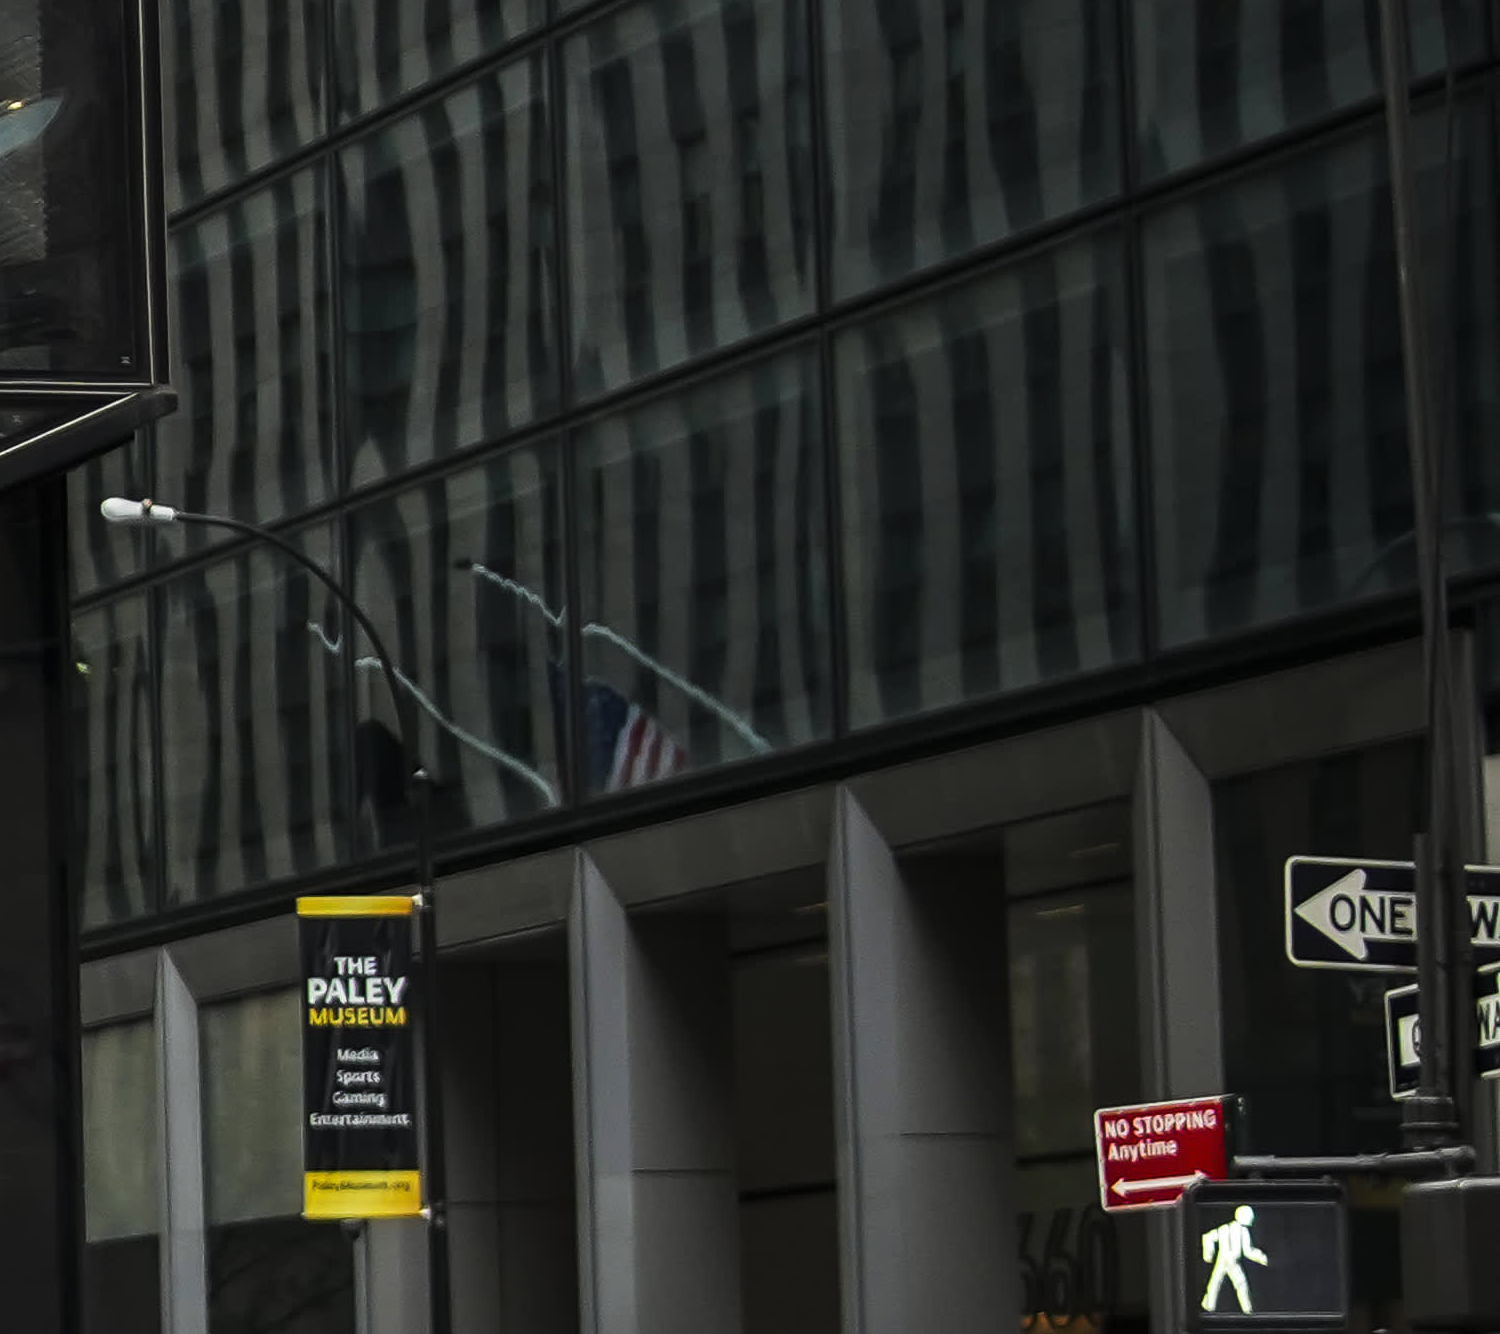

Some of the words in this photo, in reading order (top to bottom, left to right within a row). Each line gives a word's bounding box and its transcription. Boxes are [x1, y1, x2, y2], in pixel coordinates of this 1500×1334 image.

[1329, 893, 1414, 936] ONE
[334, 956, 377, 976] THE
[307, 976, 406, 1006] PALEY
[309, 1007, 406, 1028] MUSEUM
[337, 1048, 380, 1062] Media
[336, 1070, 381, 1085] Sports
[332, 1091, 387, 1108] Gaming
[310, 1112, 411, 1127] Entertainment
[1105, 1118, 1128, 1140] NO
[1132, 1109, 1217, 1136] STOPPING
[1108, 1138, 1179, 1162] Anytime
